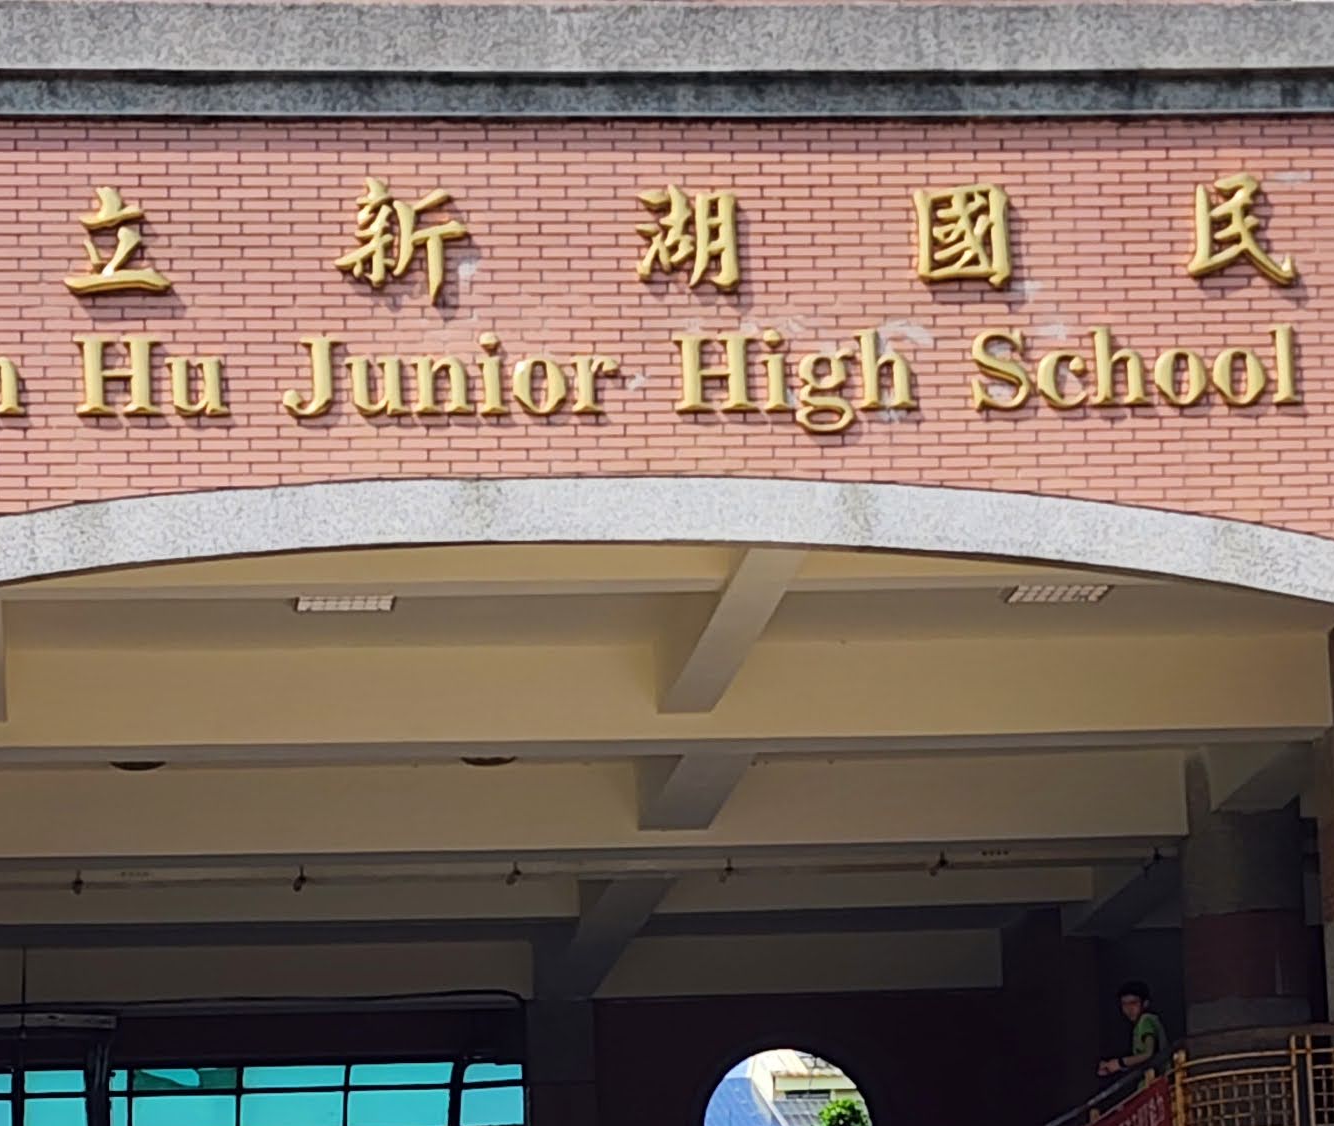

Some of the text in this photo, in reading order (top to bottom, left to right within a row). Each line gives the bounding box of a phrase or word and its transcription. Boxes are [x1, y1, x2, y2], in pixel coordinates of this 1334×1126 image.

[73, 334, 224, 417] Hu
[282, 331, 618, 423] Junior
[672, 328, 913, 434] High
[970, 322, 1299, 411] School
